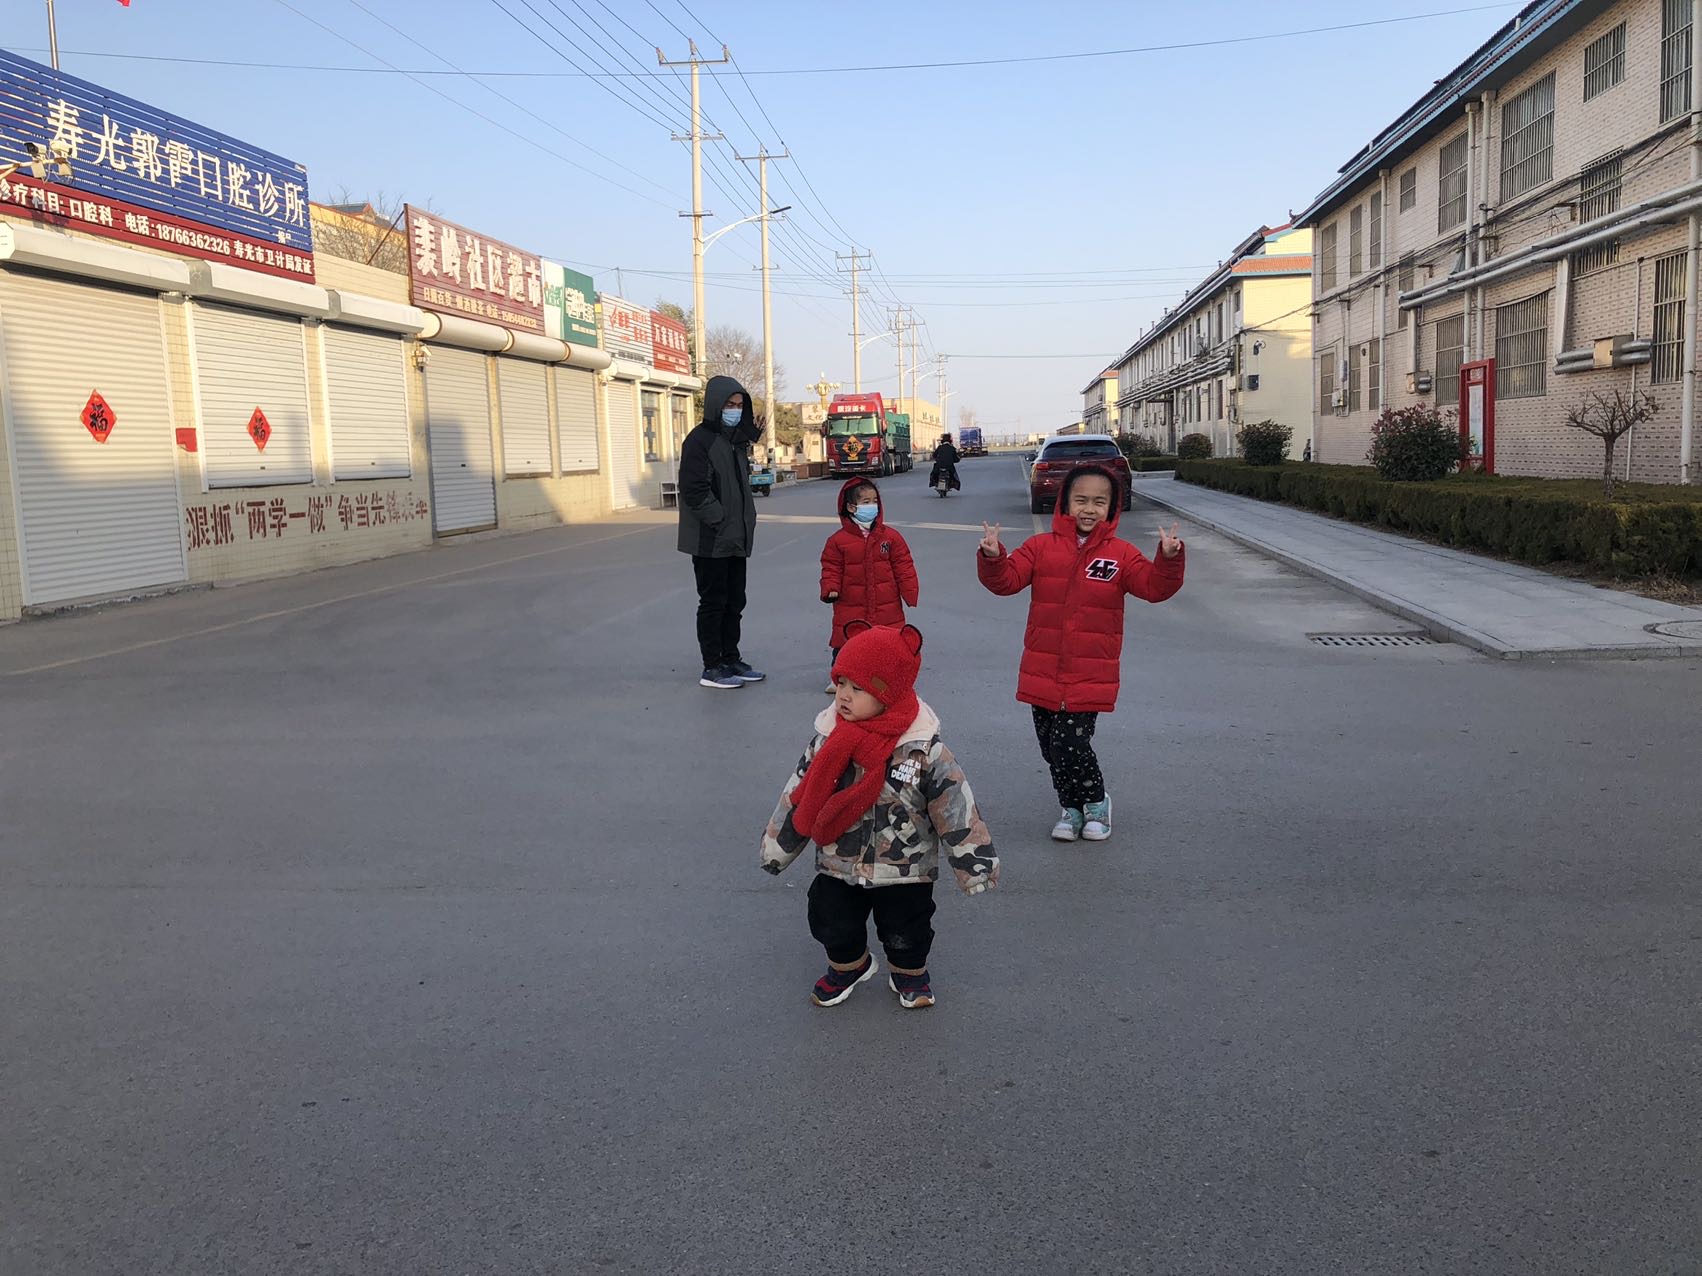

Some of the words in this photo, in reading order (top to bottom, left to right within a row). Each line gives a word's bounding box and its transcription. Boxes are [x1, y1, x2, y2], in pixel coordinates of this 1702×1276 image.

[233, 239, 313, 275] 寿光市卫计局发证
